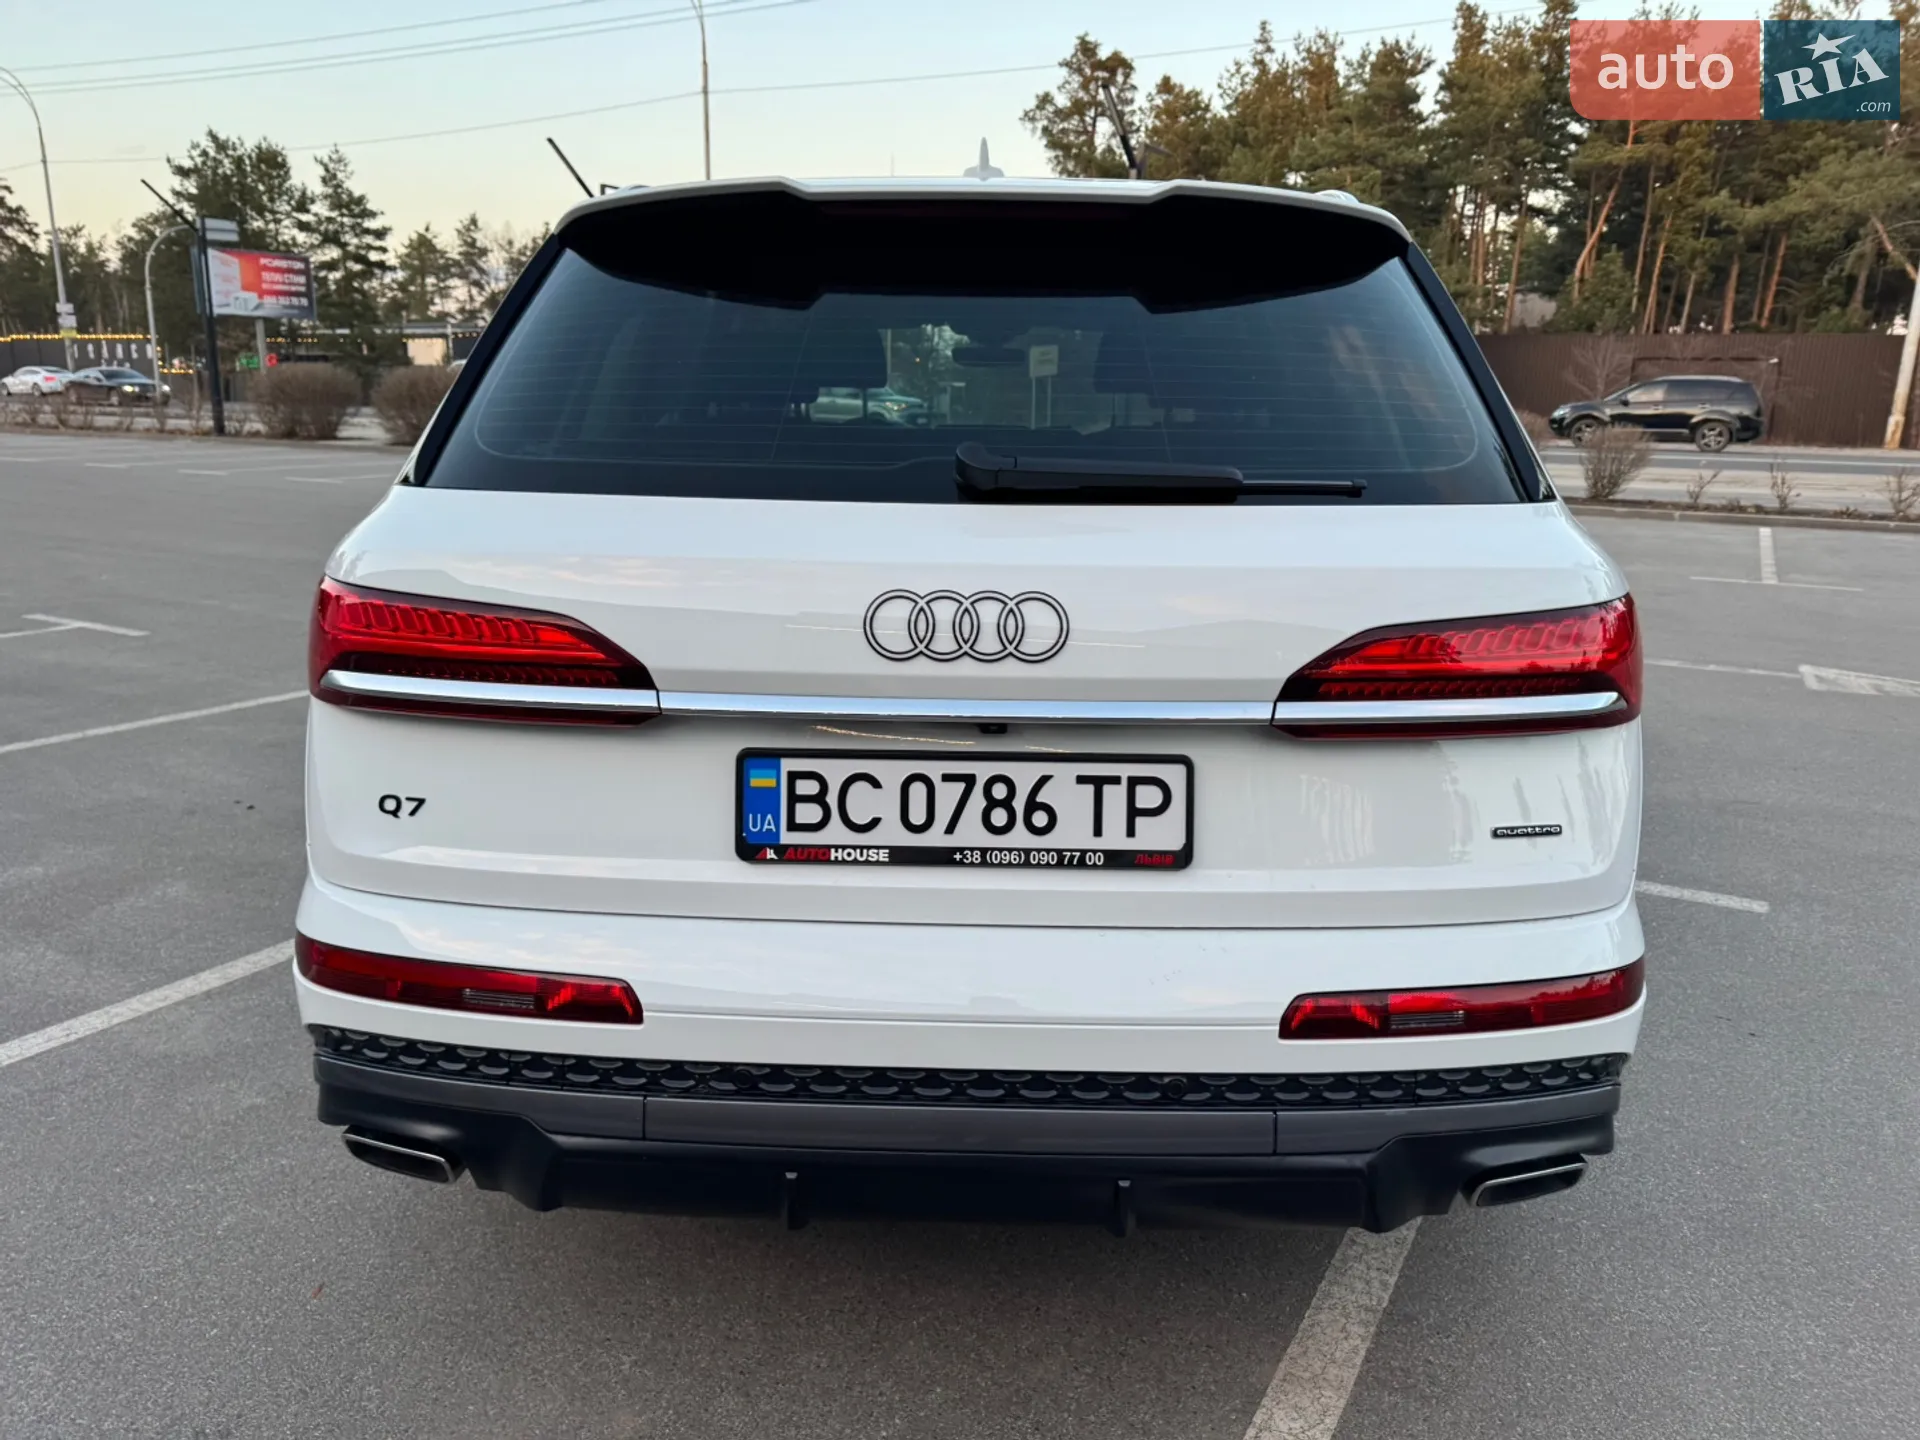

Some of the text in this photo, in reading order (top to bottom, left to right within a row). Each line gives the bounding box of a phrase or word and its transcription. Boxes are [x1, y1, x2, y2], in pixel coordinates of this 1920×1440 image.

[378, 794, 427, 819] Q7
[786, 769, 1173, 838] BC 0786 TP
[749, 813, 776, 832] UA
[1496, 826, 1560, 837] quattro
[783, 847, 890, 862] AUTOHOUSE
[953, 850, 1105, 866] +38 (096) 090 77 00
